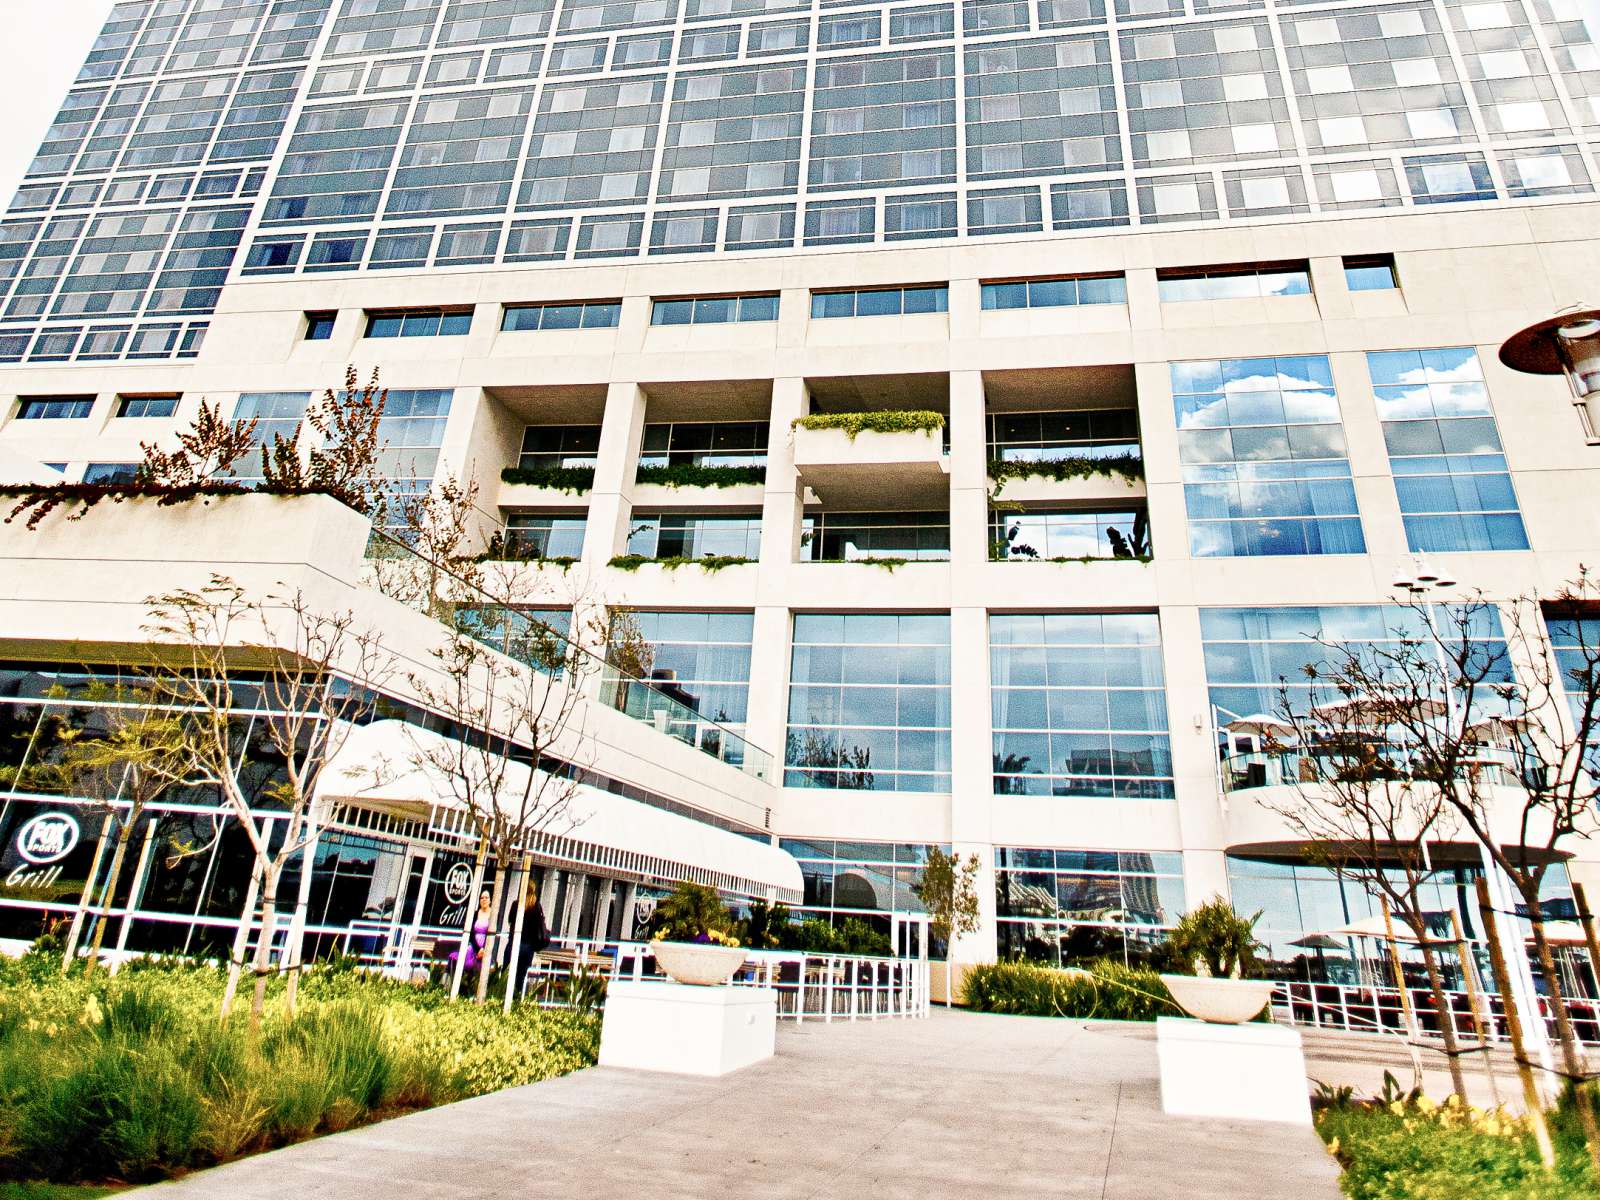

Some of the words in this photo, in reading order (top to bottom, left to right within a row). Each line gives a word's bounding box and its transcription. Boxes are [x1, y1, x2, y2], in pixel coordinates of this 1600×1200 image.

[29, 821, 70, 847] FOX
[6, 863, 64, 888] Grill
[451, 869, 469, 889] FOX
[449, 888, 466, 896] SPORTS
[439, 905, 467, 925] Grill
